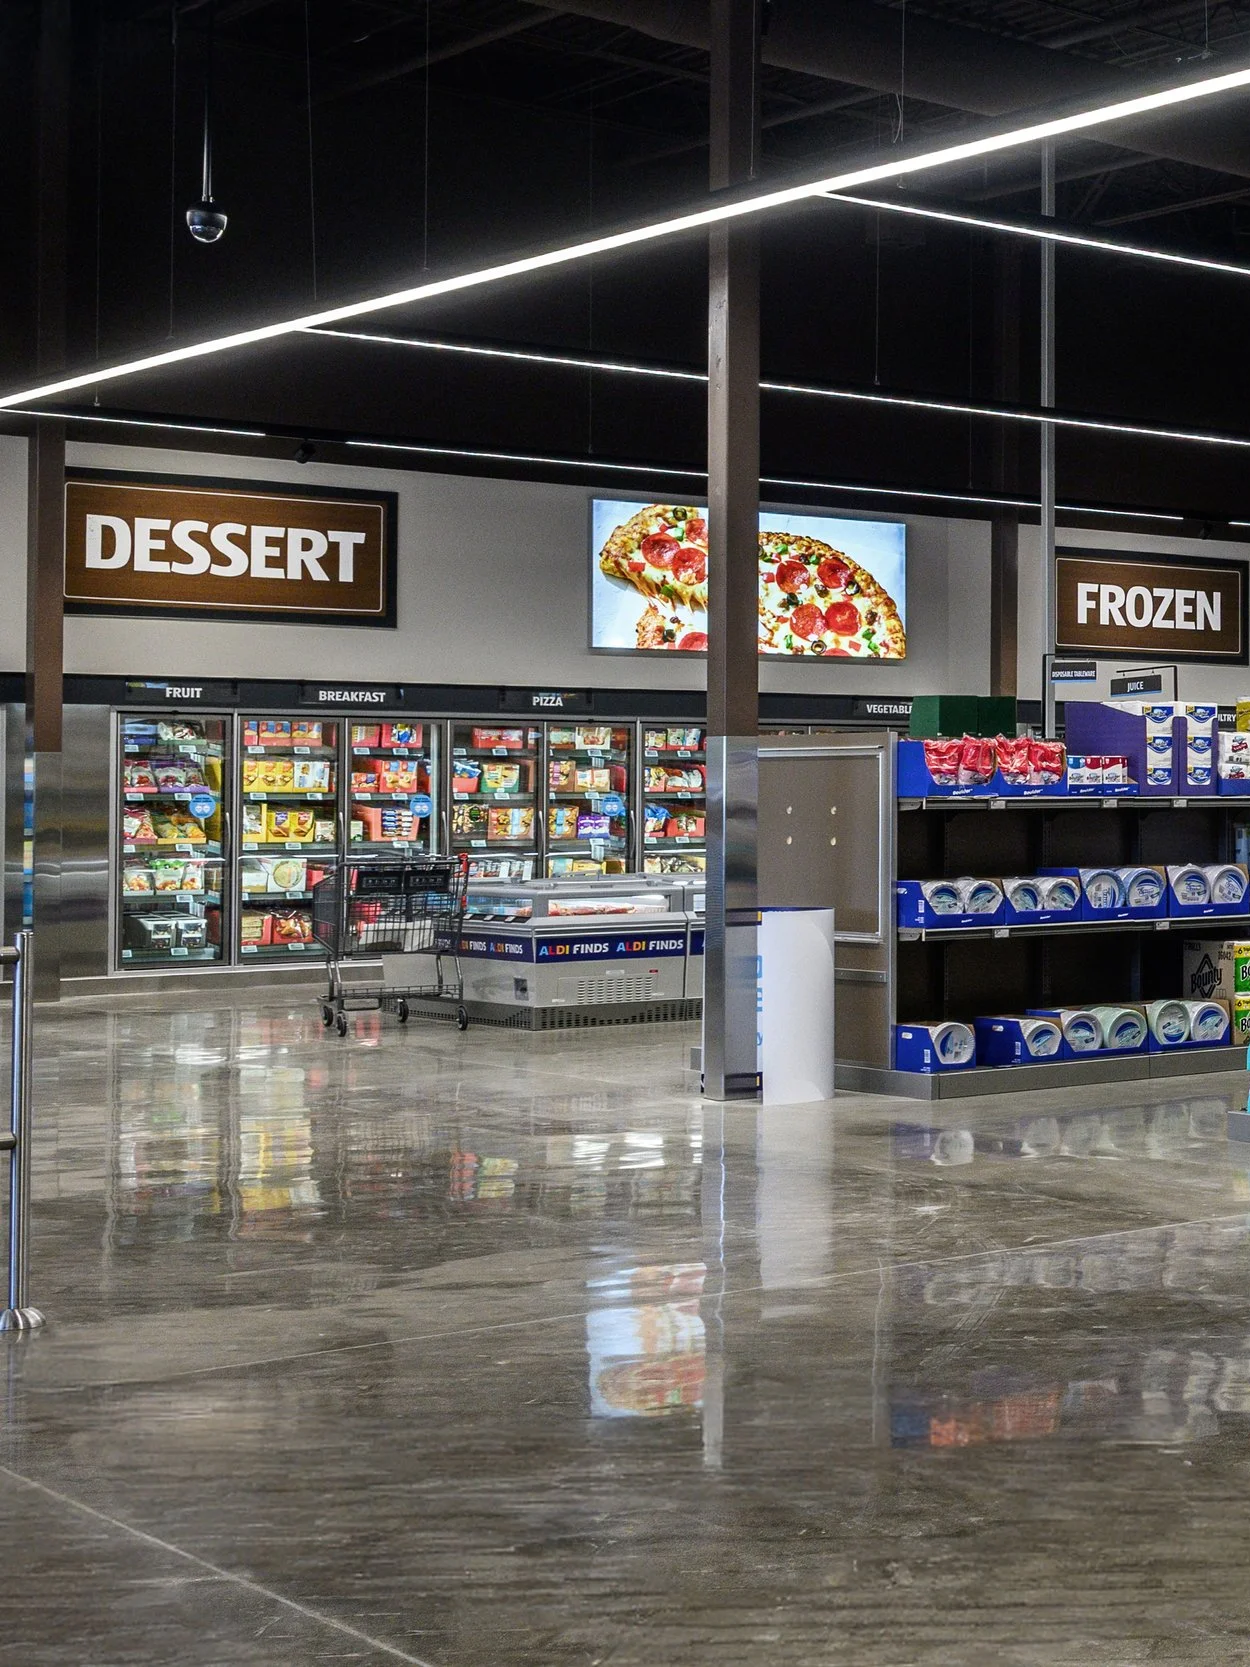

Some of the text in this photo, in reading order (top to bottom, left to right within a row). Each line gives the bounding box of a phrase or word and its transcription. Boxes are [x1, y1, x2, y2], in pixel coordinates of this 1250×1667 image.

[85, 513, 366, 583] DESSERT
[1077, 582, 1221, 631] FROZEN
[165, 687, 203, 699] FRUIT
[1127, 681, 1144, 692] JUICE
[318, 690, 386, 703] BREAKFAST
[532, 695, 563, 707] PIZZA
[469, 940, 486, 951] FINDS
[490, 941, 504, 952] ALDI
[505, 943, 523, 955] FINDS
[539, 939, 684, 956] ALDI FINDS ALDI FINDS
[1190, 965, 1223, 994] Bounty
